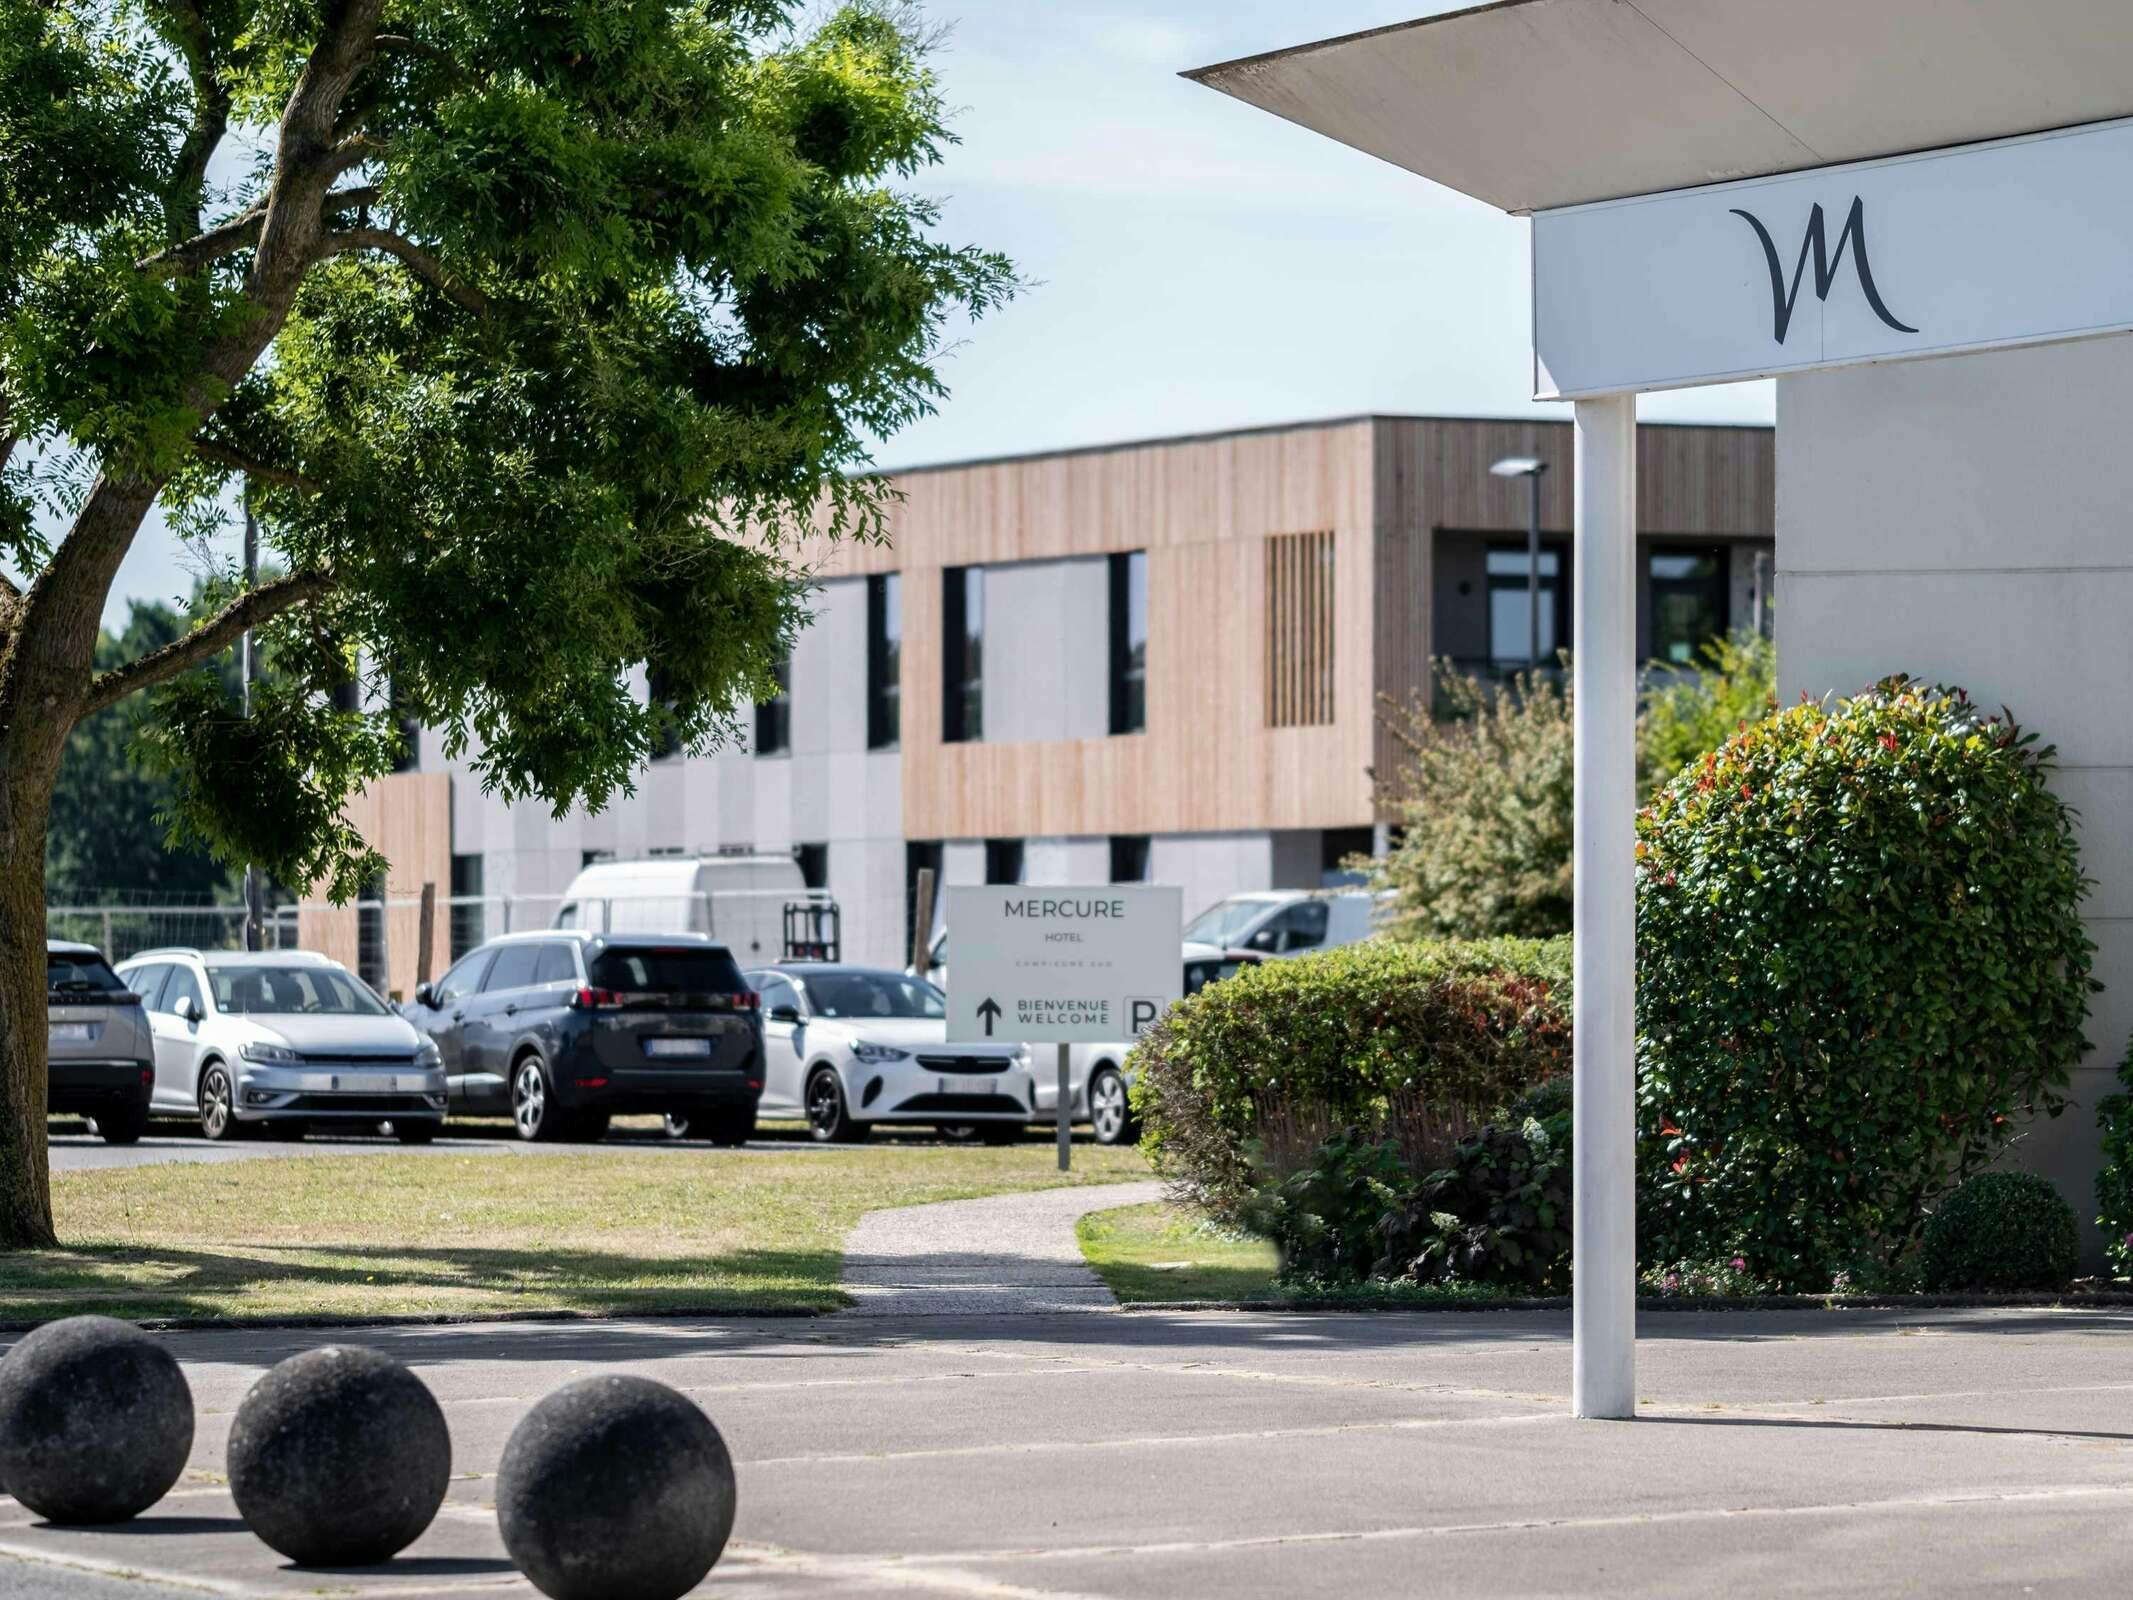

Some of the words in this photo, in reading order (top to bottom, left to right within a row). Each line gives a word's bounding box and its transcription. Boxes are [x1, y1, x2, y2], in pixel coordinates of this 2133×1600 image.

[1005, 900, 1125, 918] MERCURE
[1045, 933, 1083, 943] HOTEL
[1018, 999, 1109, 1011] BIENVENUE
[1018, 1013, 1109, 1024] WELCOME
[1132, 1000, 1157, 1034] P
